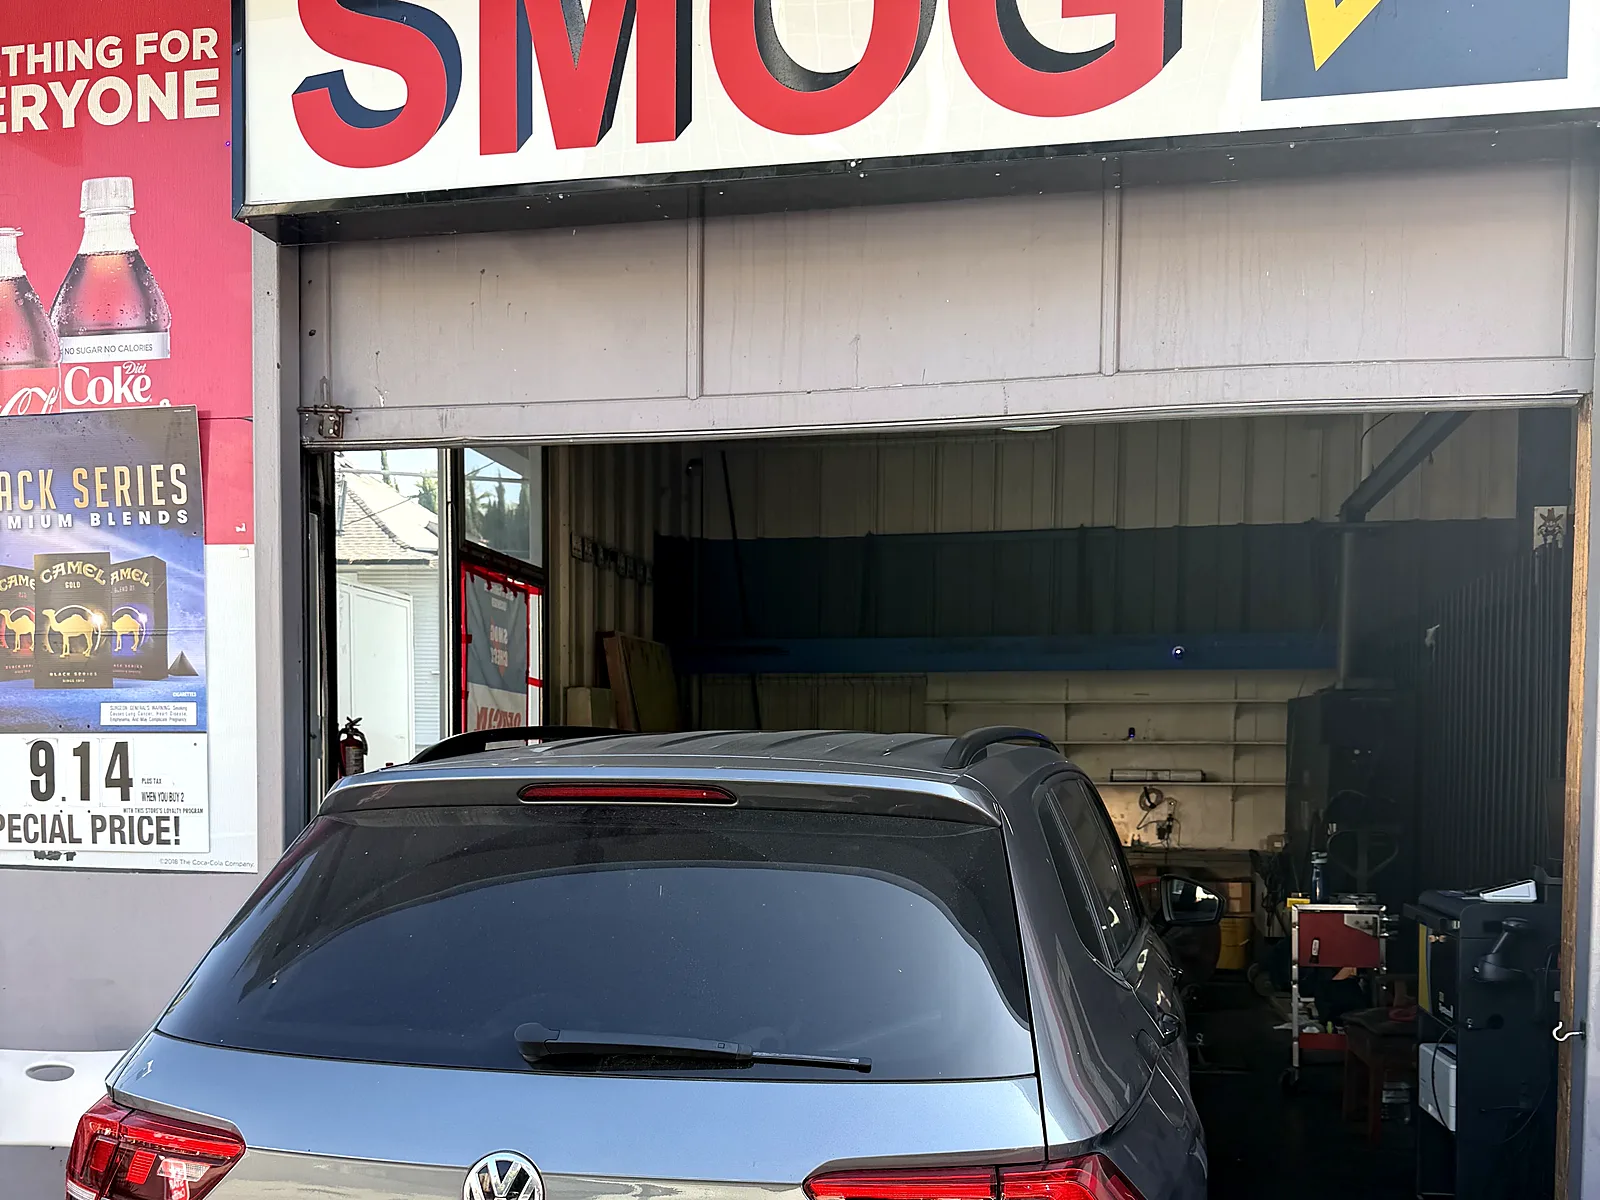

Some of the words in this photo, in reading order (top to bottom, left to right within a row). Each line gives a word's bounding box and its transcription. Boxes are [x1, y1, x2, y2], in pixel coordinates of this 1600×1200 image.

[1, 36, 123, 77] THING
[136, 27, 219, 66] FOR
[292, 0, 1182, 168] SMOG
[0, 68, 220, 134] RYONE
[64, 346, 75, 355] NO
[76, 345, 103, 355] SUGAR
[104, 345, 117, 353] NO
[118, 343, 153, 353] CALORIES
[123, 361, 147, 375] Diet
[64, 366, 152, 406] Coke
[72, 463, 188, 508] SERIES
[7, 513, 73, 529] MIUM
[90, 509, 189, 526] BLENDS
[41, 561, 107, 586] CAMEL
[141, 791, 156, 802] WHEN
[157, 791, 169, 802] YOU
[168, 791, 181, 802] BUY
[180, 792, 185, 802] 2
[91, 814, 180, 846] PRICE!
